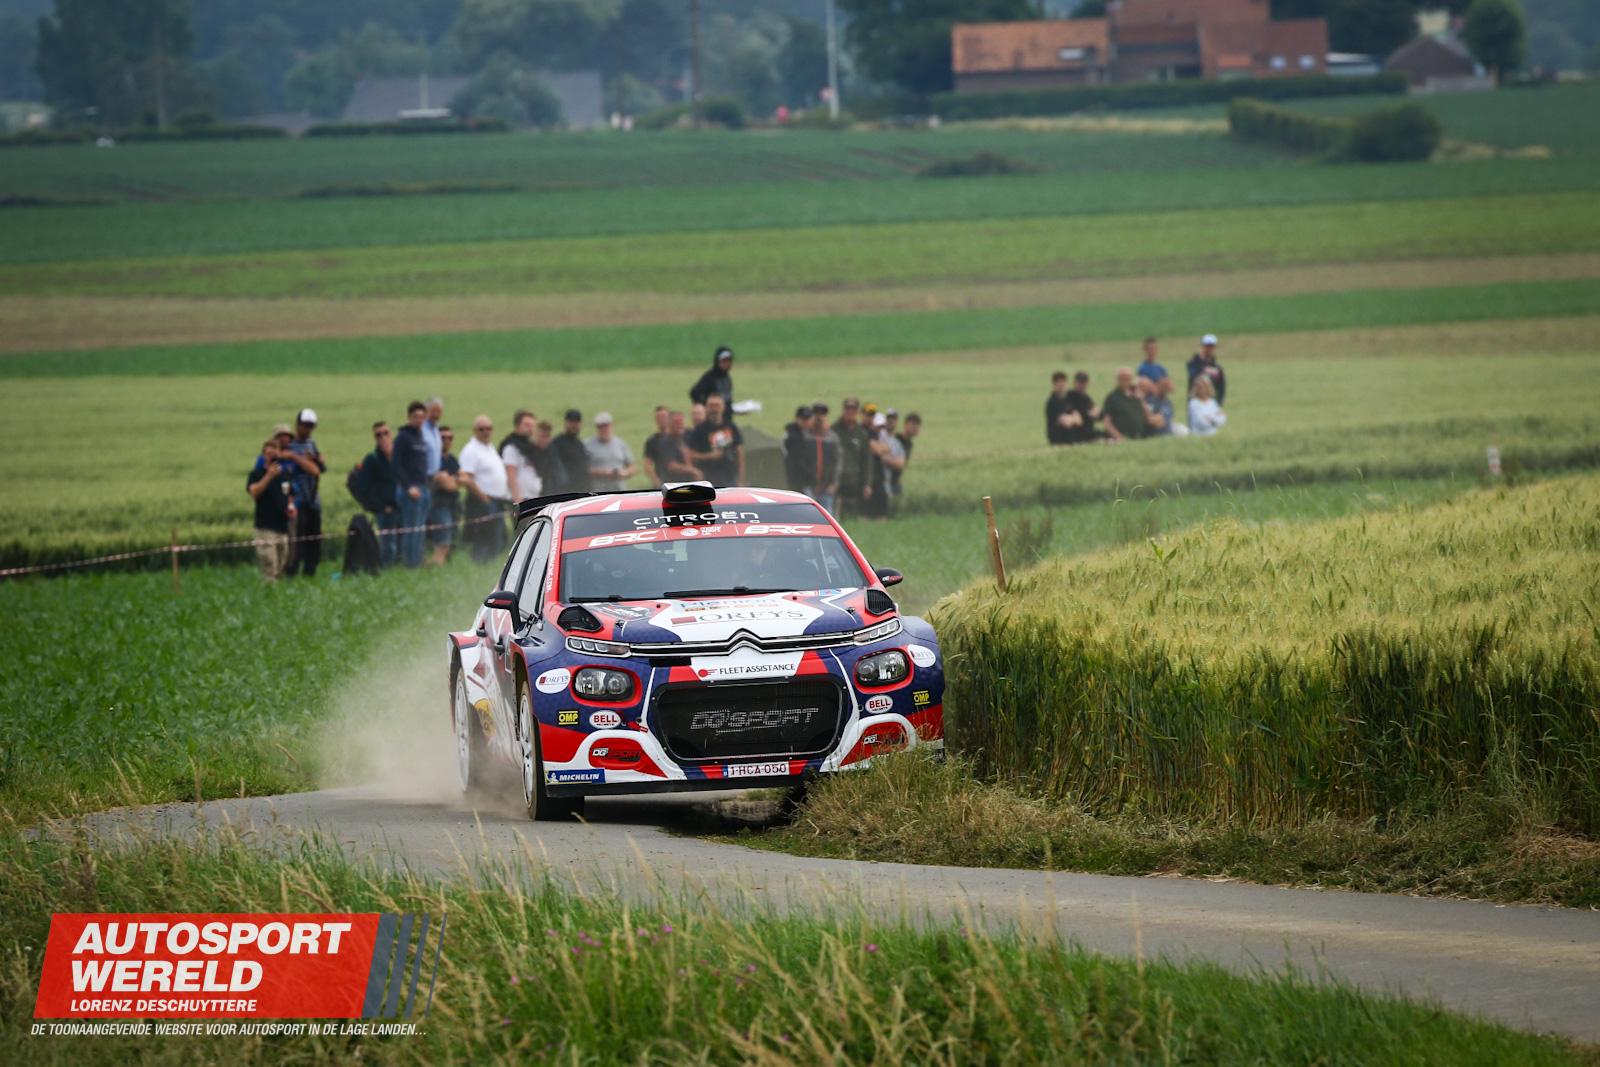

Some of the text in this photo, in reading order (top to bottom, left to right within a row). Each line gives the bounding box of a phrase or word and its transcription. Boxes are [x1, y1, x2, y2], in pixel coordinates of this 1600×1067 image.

[744, 525, 814, 535] BRC
[588, 530, 659, 548] BRC
[719, 663, 796, 675] FLEET ASSISTANCE
[869, 698, 891, 708] BELL
[913, 693, 930, 703] OMP
[558, 713, 579, 722] OMP
[593, 714, 617, 722] BELL
[730, 763, 788, 776] 1-HCA-050
[559, 773, 600, 781] MICHELIN
